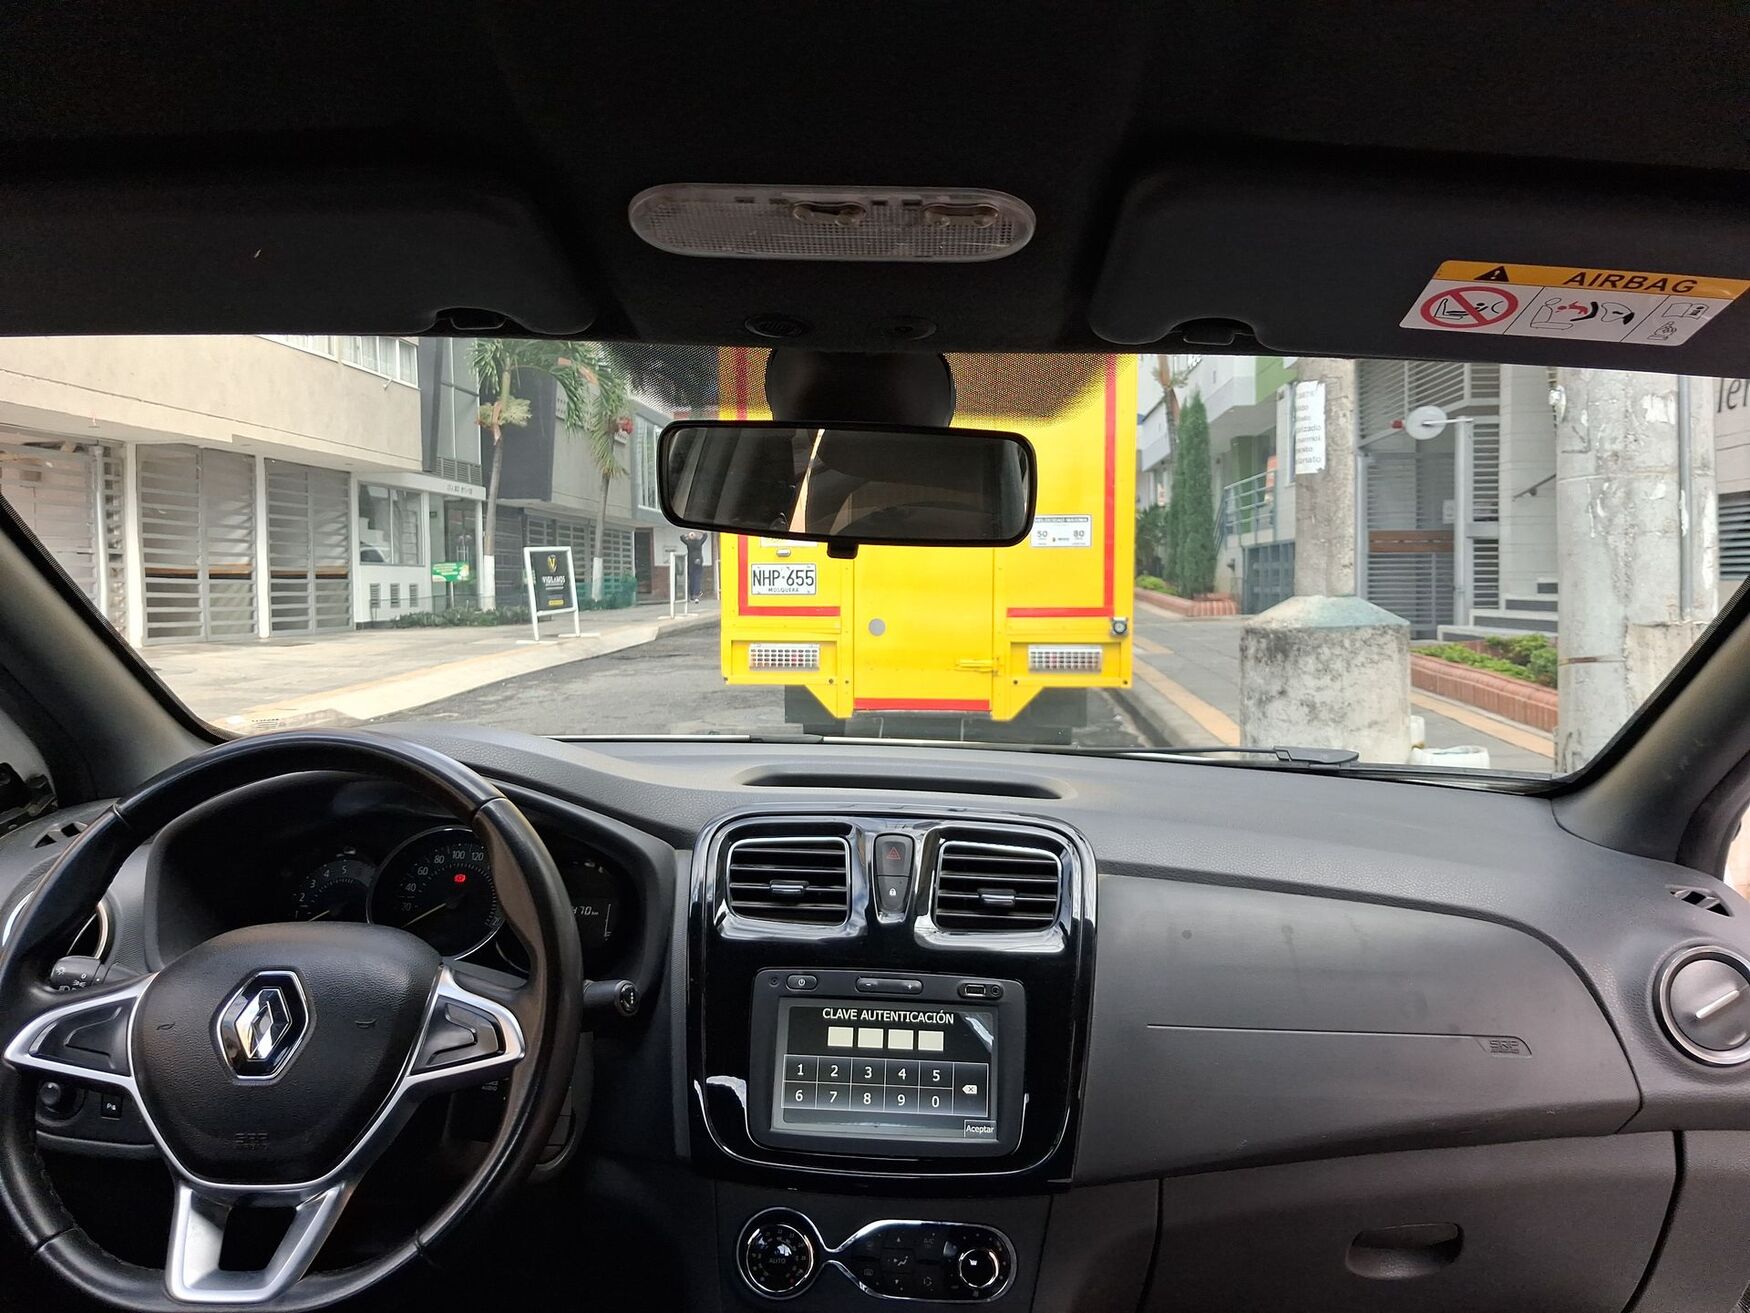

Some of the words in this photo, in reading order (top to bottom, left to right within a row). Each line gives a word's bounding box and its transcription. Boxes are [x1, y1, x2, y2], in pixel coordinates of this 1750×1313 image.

[1563, 271, 1698, 294] AIRBAG
[433, 855, 445, 864] 80
[452, 850, 466, 860] 100
[471, 852, 484, 861] 120
[417, 866, 429, 876] 60
[822, 1007, 858, 1021] CLAVE
[860, 1009, 955, 1025] AUTENTICACIÓN
[797, 1064, 804, 1075] 1
[830, 1065, 839, 1077] 2
[864, 1066, 873, 1078] 3
[897, 1068, 907, 1080] 4
[932, 1069, 941, 1081] 5
[795, 1090, 804, 1102] 6
[829, 1091, 838, 1103] 7
[863, 1092, 872, 1104] 8
[897, 1094, 906, 1106] 9
[931, 1095, 940, 1107] 0
[965, 1124, 995, 1135] Aceptar
